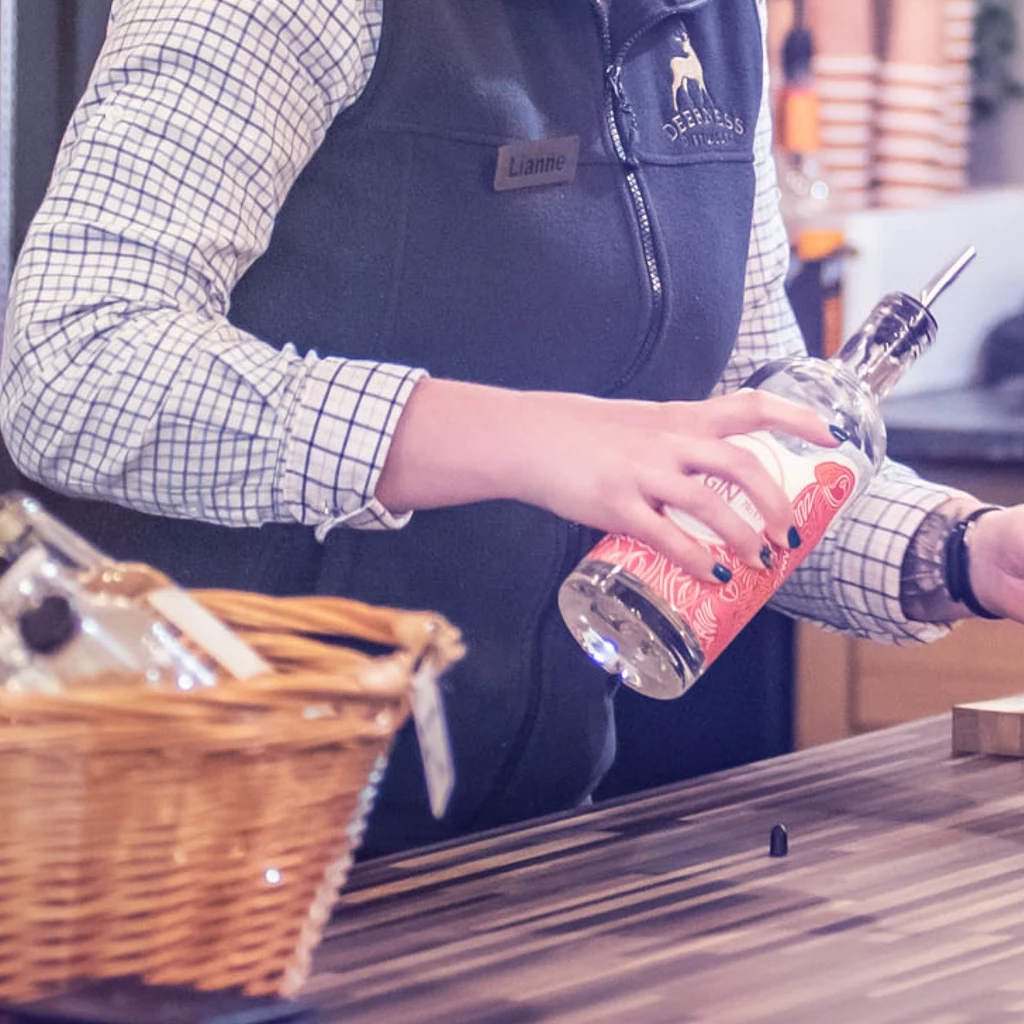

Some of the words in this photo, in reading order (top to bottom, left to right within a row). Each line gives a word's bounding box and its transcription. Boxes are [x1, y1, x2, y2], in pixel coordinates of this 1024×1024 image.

[661, 107, 745, 142] DEERNESS
[508, 154, 565, 178] Lianne
[703, 472, 742, 502] GIN
